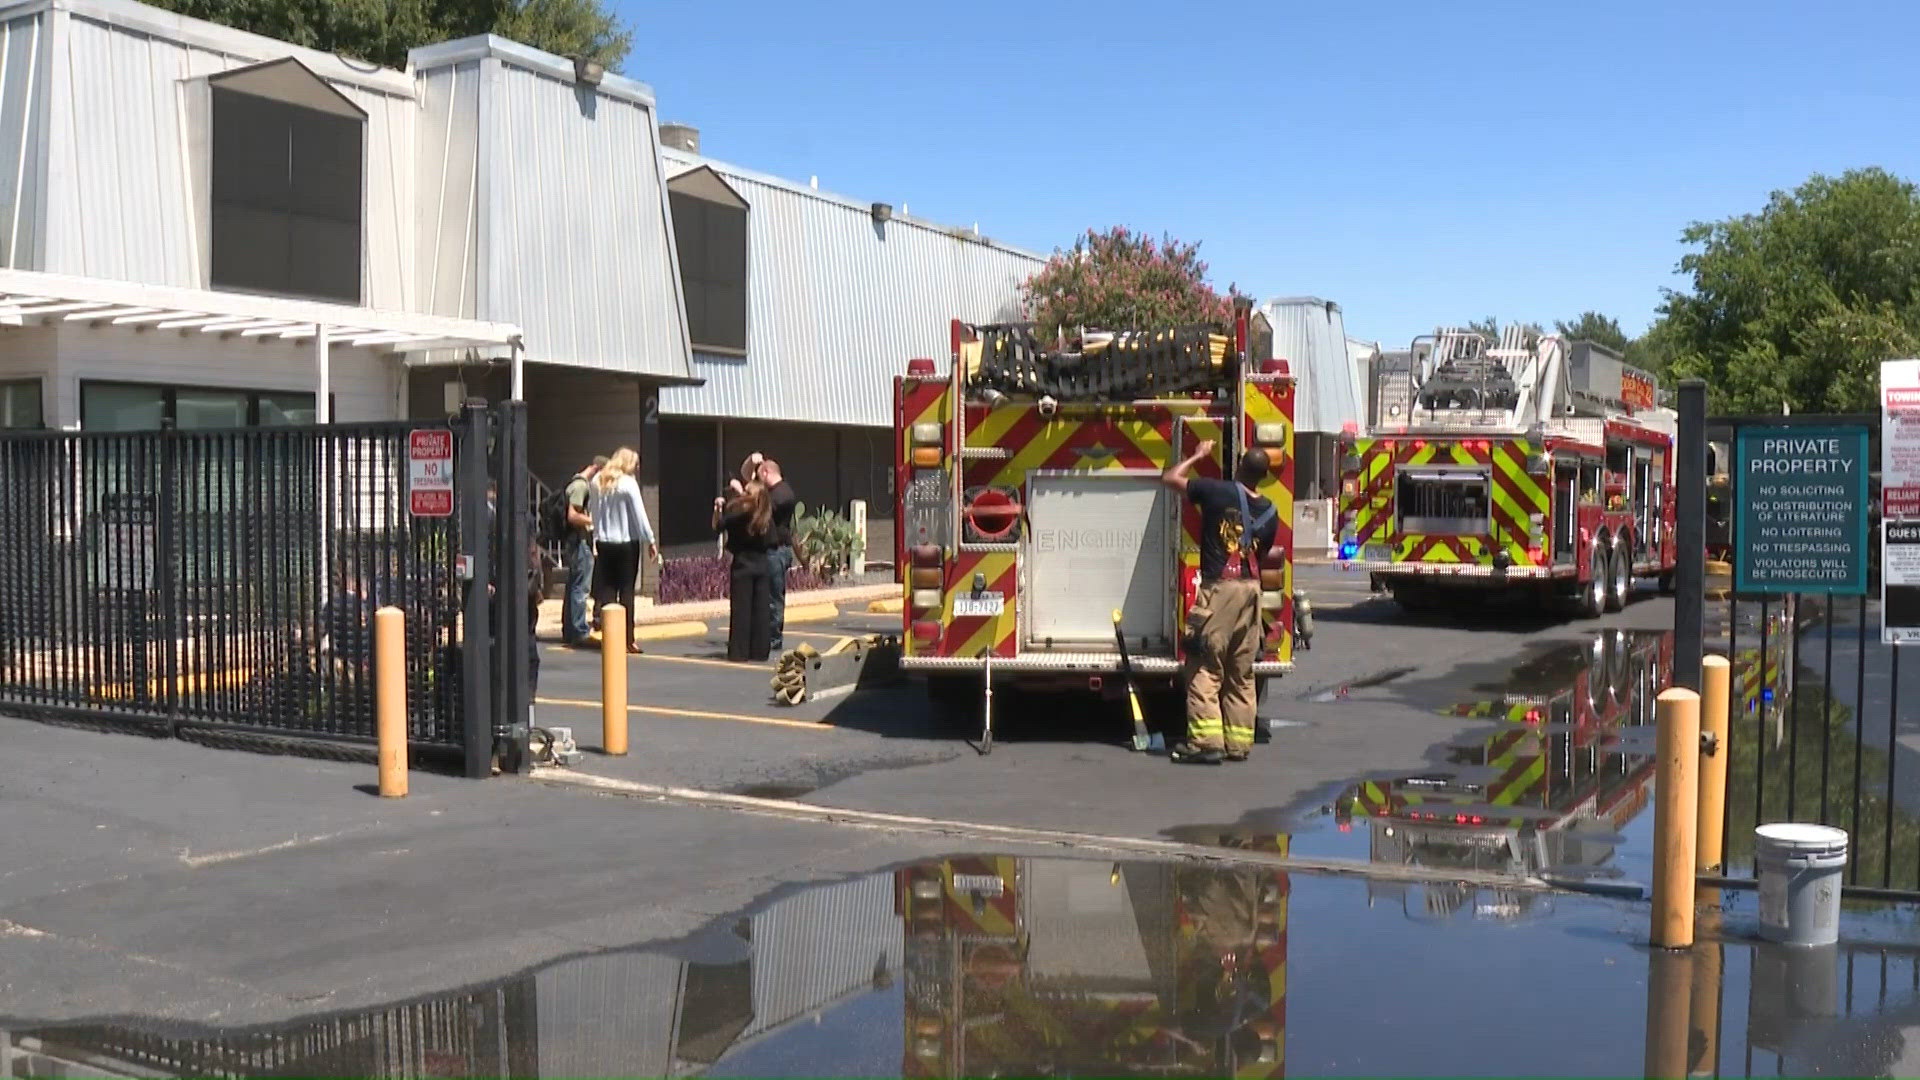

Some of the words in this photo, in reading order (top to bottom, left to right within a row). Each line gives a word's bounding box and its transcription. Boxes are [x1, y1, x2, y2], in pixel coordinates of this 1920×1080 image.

[416, 435, 445, 447] PRIVATE
[1763, 438, 1840, 454] PRIVATE
[412, 446, 450, 458] PROPERTY
[424, 463, 438, 476] NO
[1751, 458, 1853, 474] PROPERTY
[1759, 485, 1777, 496] NO
[1780, 485, 1845, 496] SOLICITING
[1887, 489, 1920, 501] RELIANT
[1751, 501, 1769, 511] NO
[1772, 501, 1852, 511] DISTRIBUTION
[1887, 504, 1919, 515] RELIANT
[1758, 512, 1773, 522] OF
[1777, 512, 1845, 522] LITERATURE
[1761, 527, 1778, 537] NO
[1781, 527, 1842, 537] LOITERING
[1752, 543, 1769, 553] NO
[1773, 543, 1851, 553] TRESPASSING
[1754, 558, 1818, 568] VIOLATORS
[1820, 558, 1848, 568] WILL
[1752, 569, 1767, 579] BE
[1770, 569, 1847, 579] PROSECUTED
